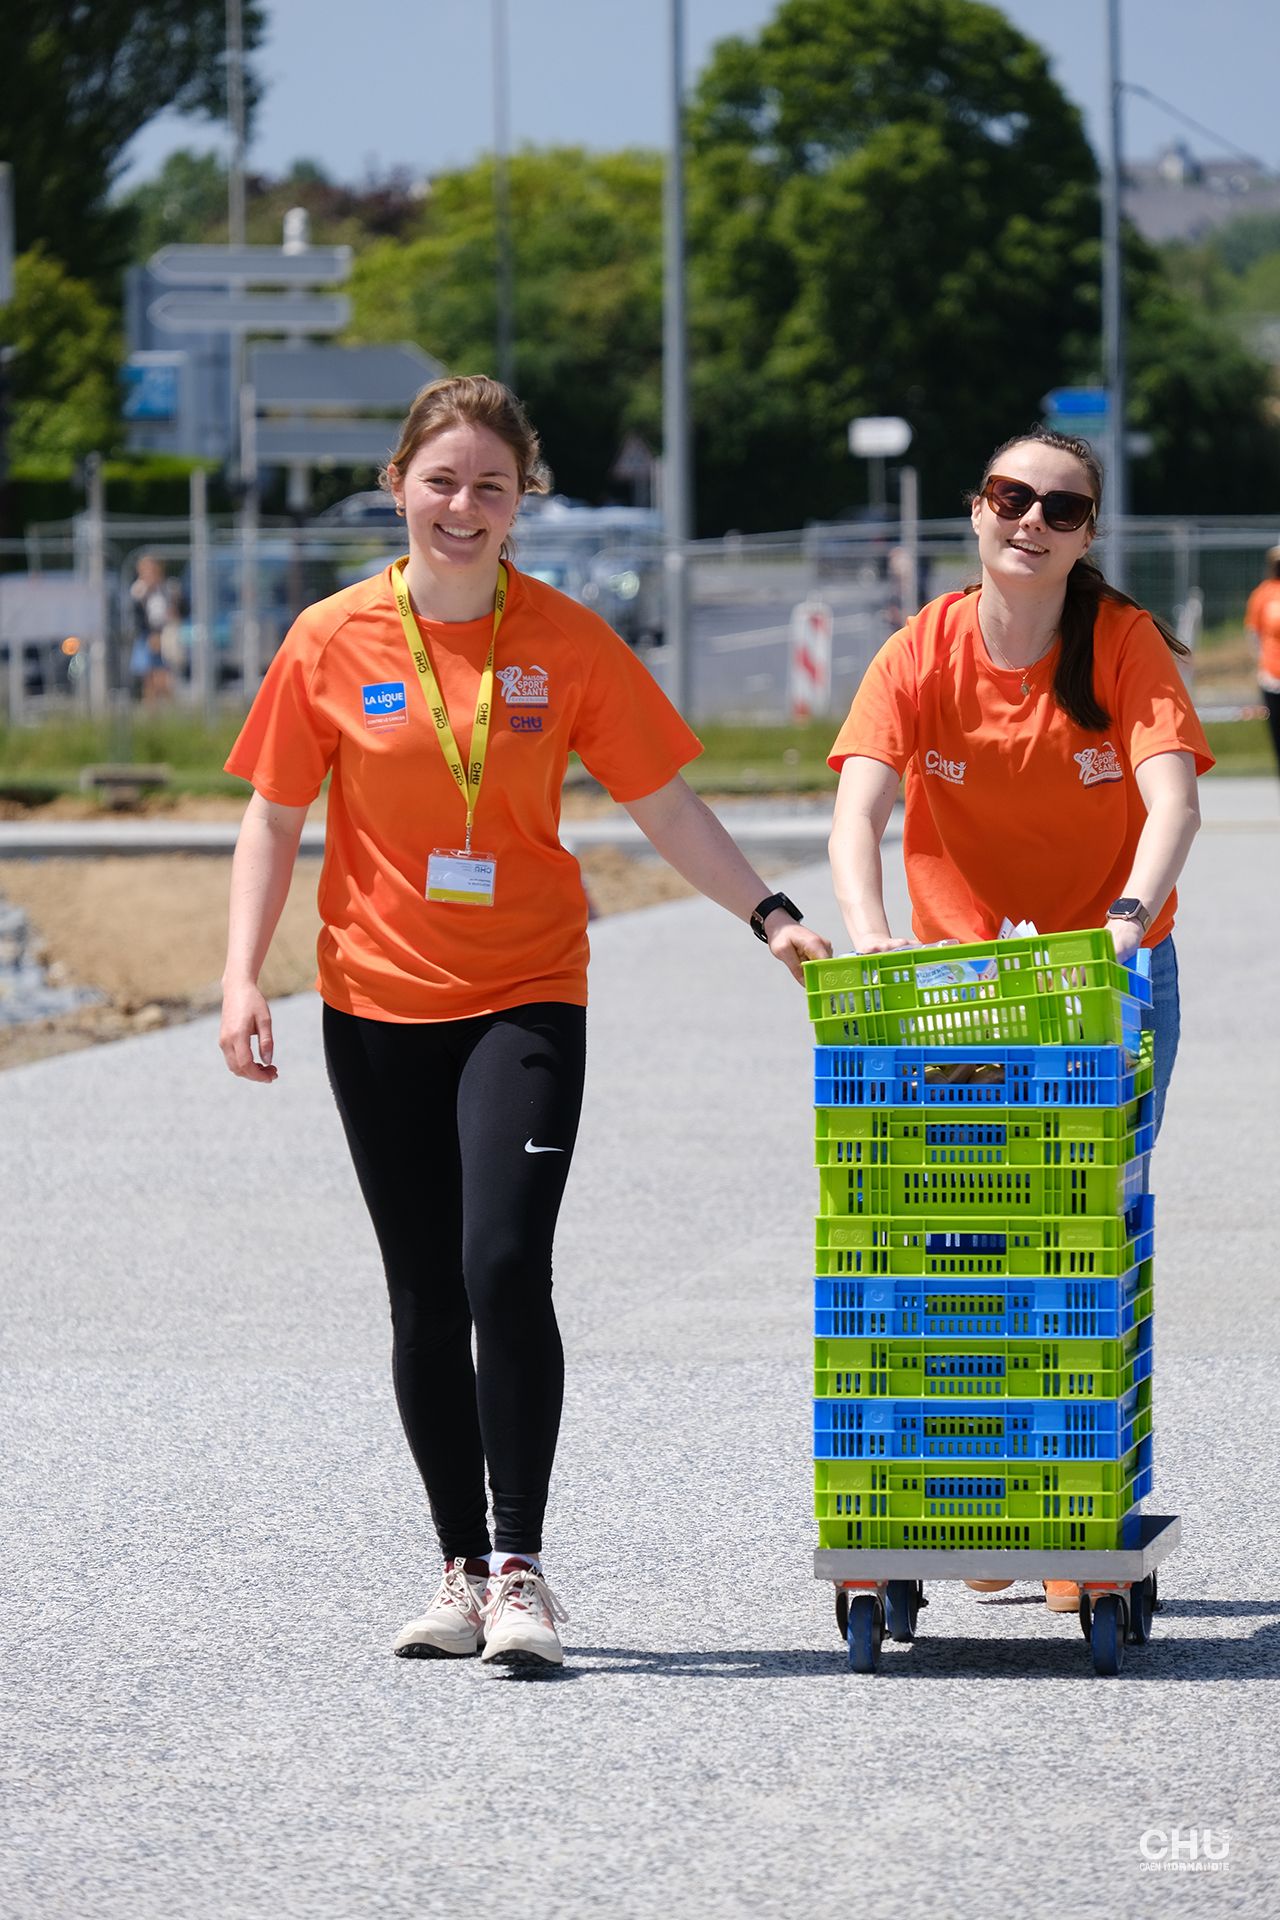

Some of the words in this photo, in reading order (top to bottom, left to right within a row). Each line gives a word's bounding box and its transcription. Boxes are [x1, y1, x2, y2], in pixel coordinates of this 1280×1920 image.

[396, 594, 408, 617] CHU
[498, 590, 506, 612] CHU
[413, 650, 427, 674] CHU
[517, 680, 545, 689] SPORT
[522, 685, 549, 696] SANTÉ
[364, 695, 377, 705] LA
[432, 706, 446, 729] CHU
[478, 702, 489, 725] CHU
[510, 715, 543, 729] CHU
[450, 763, 463, 786] CHU
[471, 761, 482, 785] CHU
[455, 1558, 463, 1567] S
